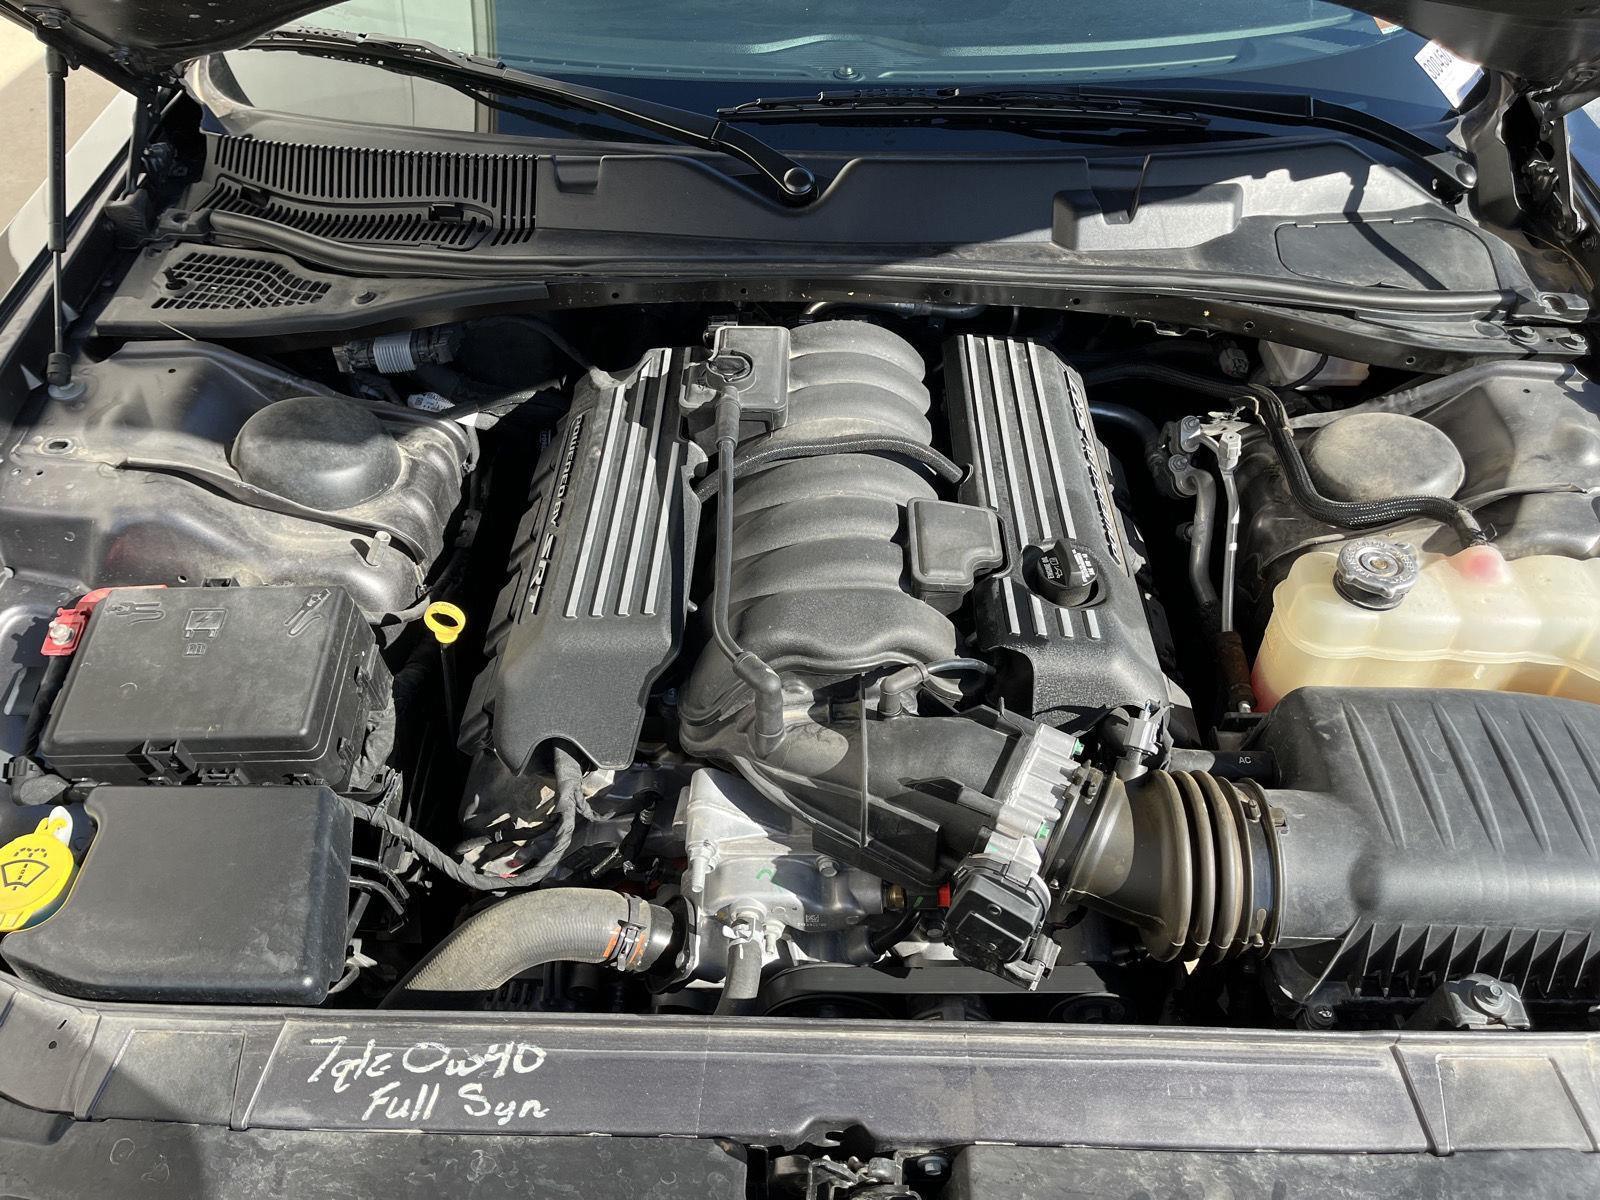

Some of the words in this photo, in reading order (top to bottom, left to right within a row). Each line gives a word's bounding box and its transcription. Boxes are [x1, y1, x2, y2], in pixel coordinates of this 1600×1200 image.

[558, 414, 584, 498] POWERED
[551, 501, 564, 527] BY
[529, 533, 556, 615] SRT
[1239, 756, 1252, 764] AC
[361, 1081, 440, 1121] Full
[458, 1083, 550, 1126] Syn
